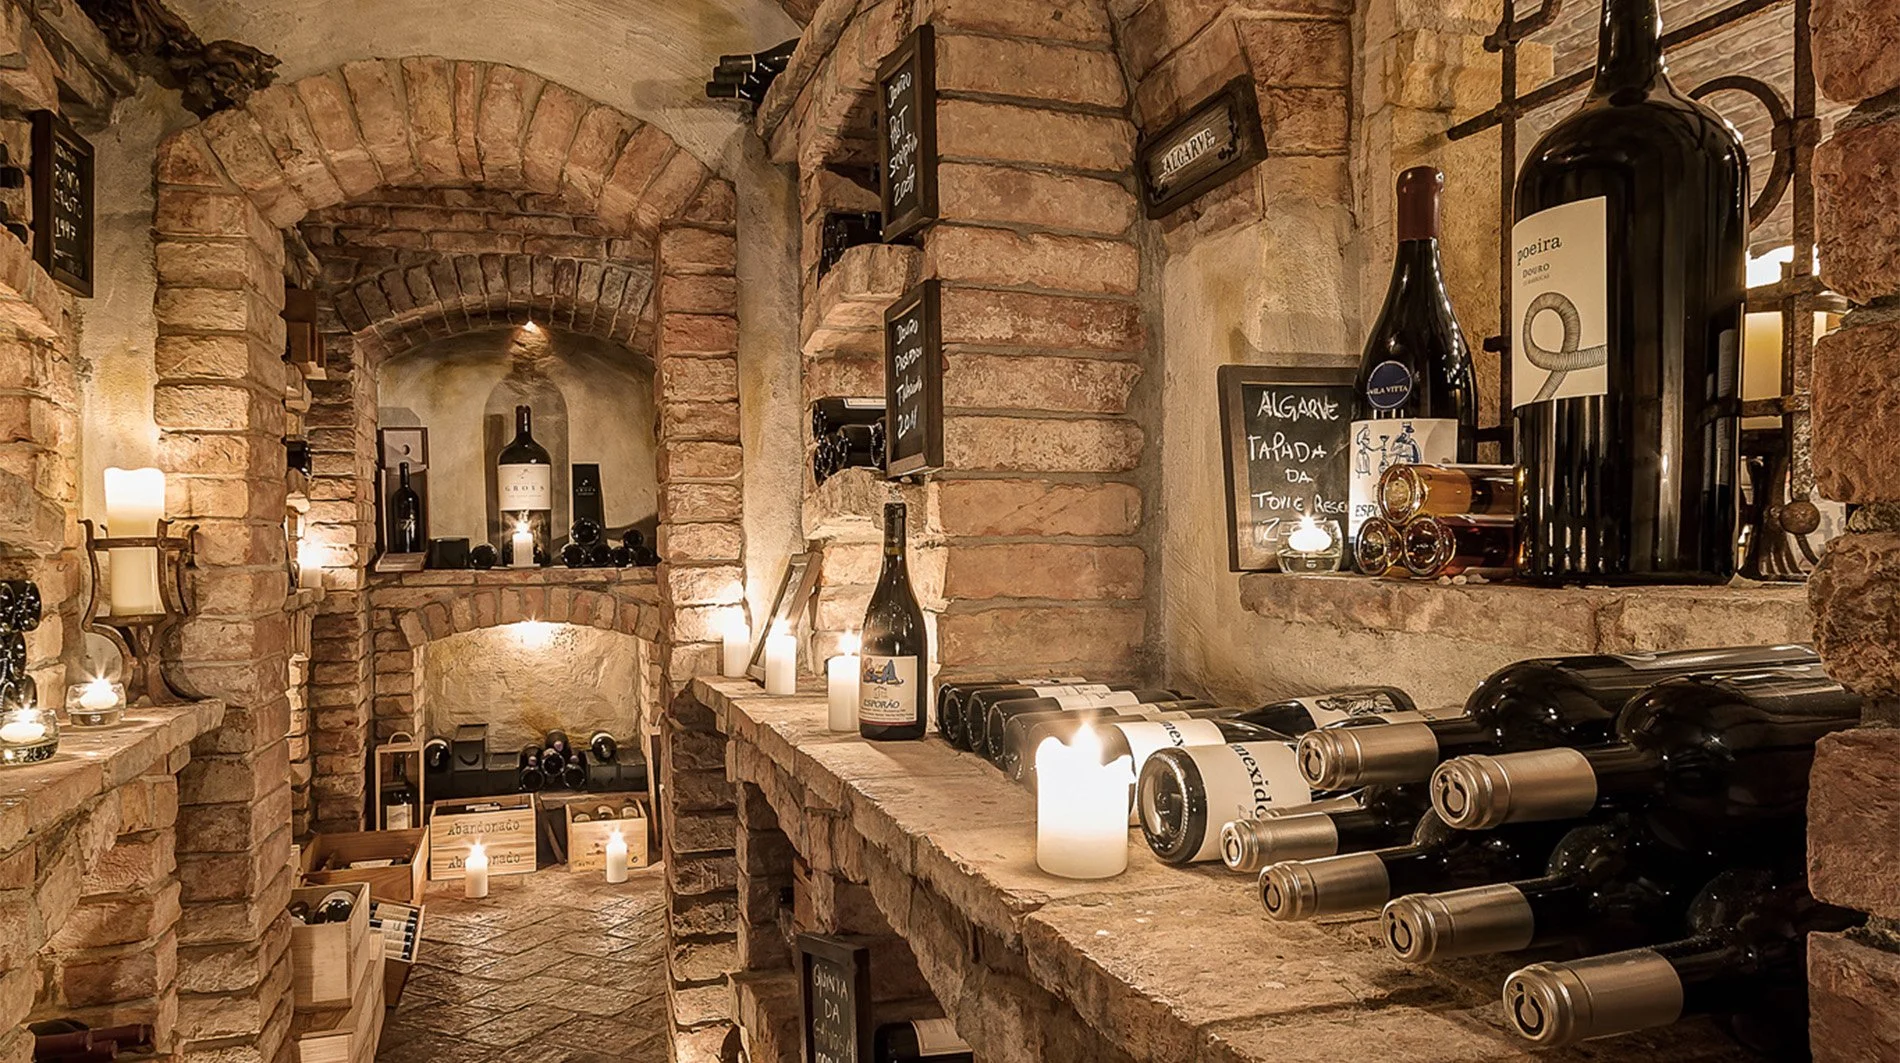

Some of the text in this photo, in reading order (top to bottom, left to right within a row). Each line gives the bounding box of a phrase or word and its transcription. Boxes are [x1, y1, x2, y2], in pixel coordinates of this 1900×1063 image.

[1163, 129, 1212, 172] ALGARVE
[1516, 236, 1563, 266] poeira
[1522, 262, 1550, 279] DOURO
[1257, 391, 1340, 422] ALGARVE
[1248, 432, 1327, 463] TAPADA
[1285, 468, 1314, 484] DA
[447, 819, 520, 836] Abandonado
[824, 998, 841, 1024] DA
